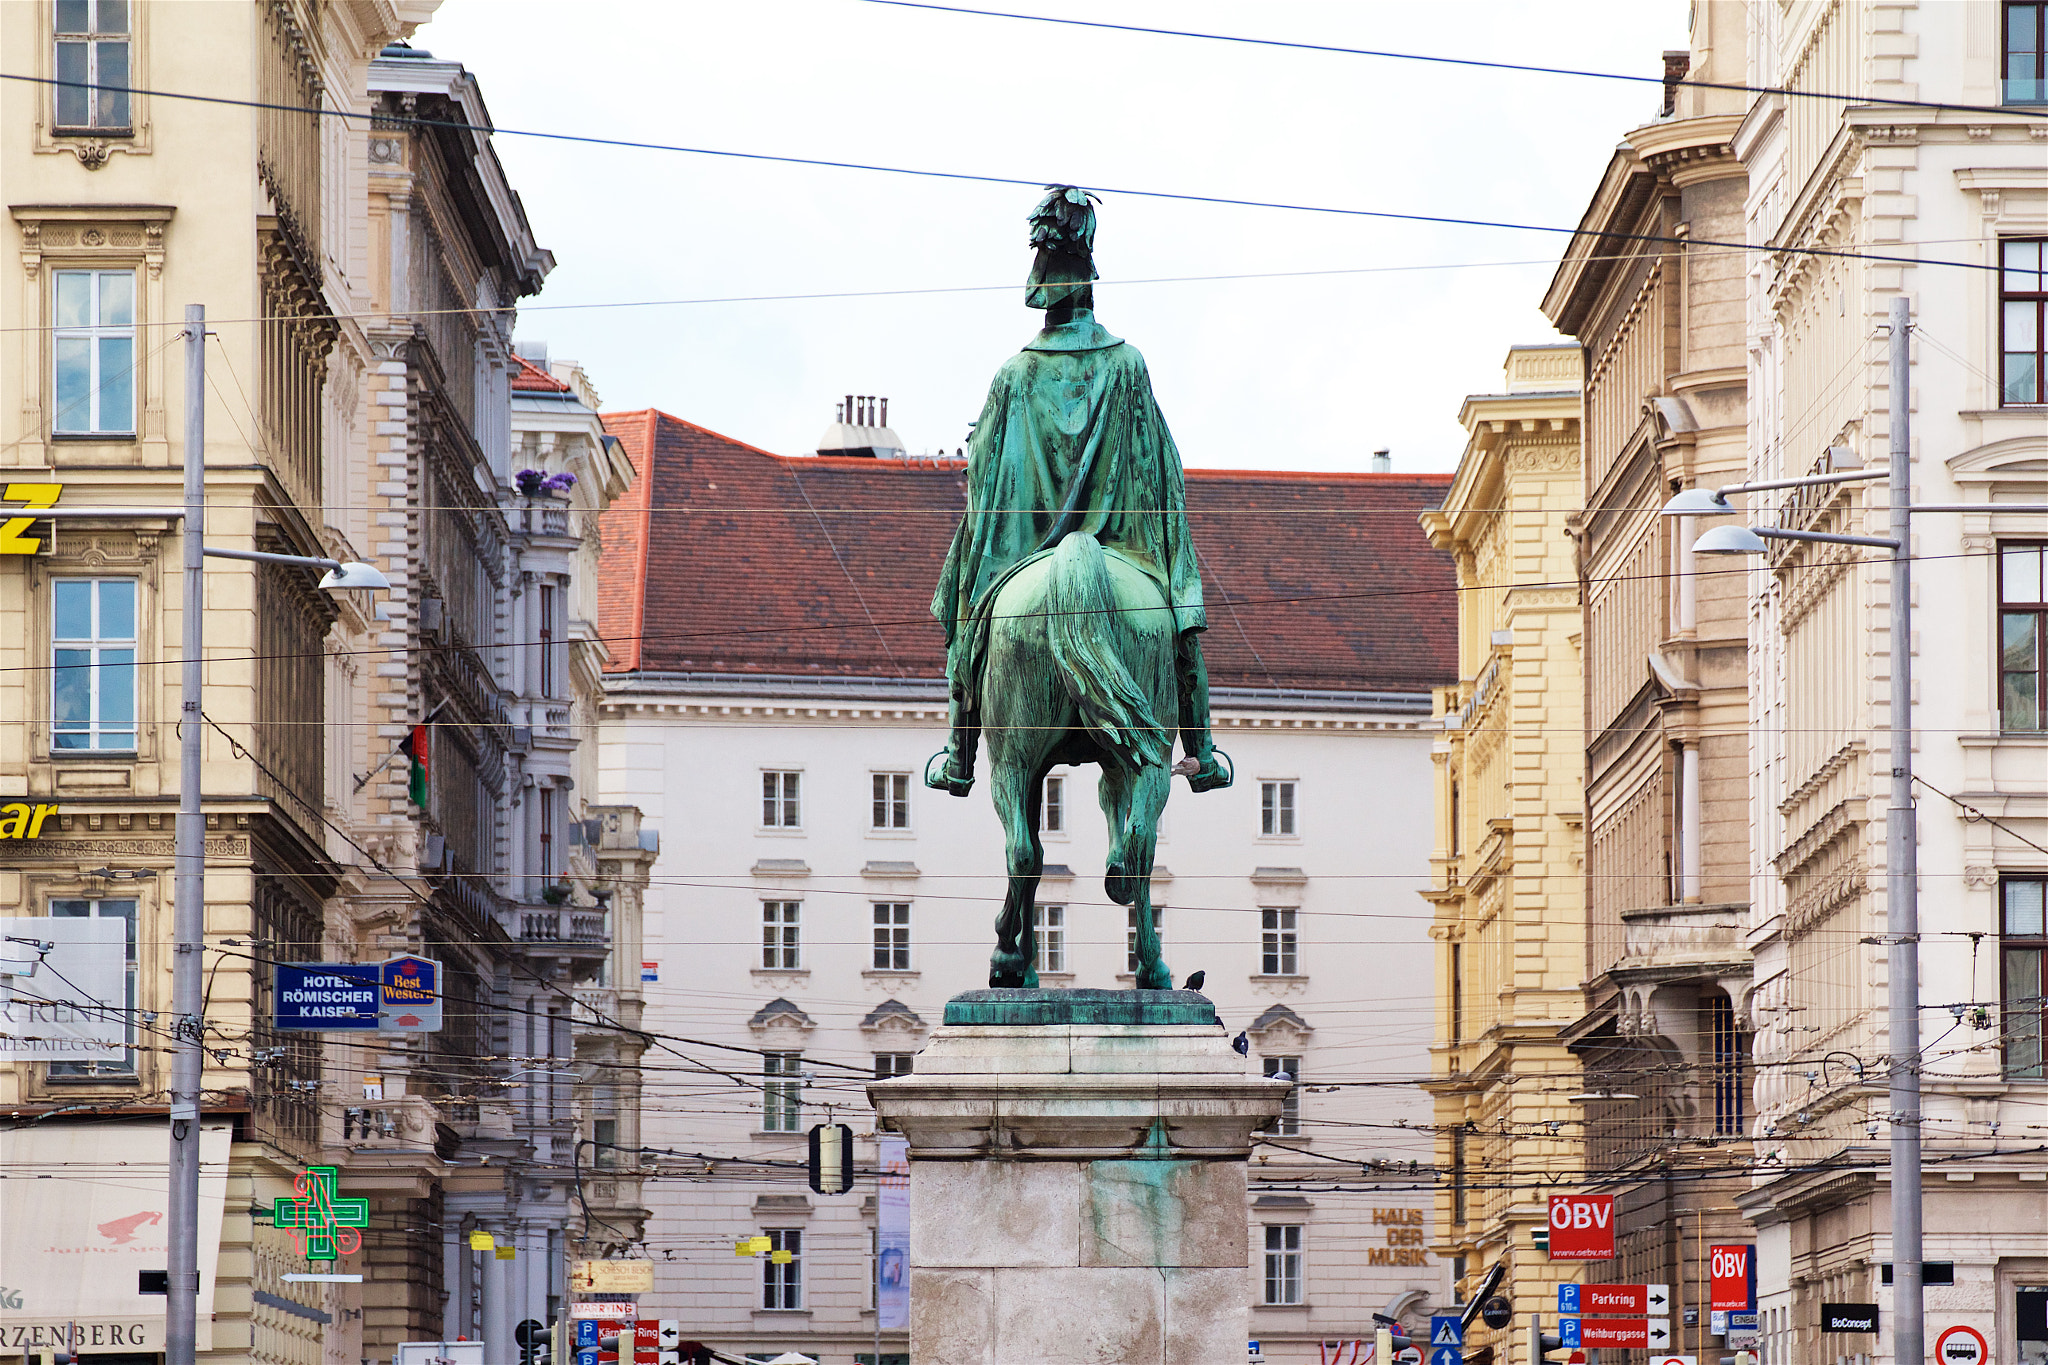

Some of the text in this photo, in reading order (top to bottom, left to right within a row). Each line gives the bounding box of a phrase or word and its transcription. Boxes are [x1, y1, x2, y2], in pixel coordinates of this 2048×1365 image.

[0, 802, 58, 839] ar
[303, 976, 353, 988] HOTEL
[393, 975, 421, 989] Best
[282, 989, 373, 1003] RÖMISCHER
[384, 986, 434, 1000] Western
[28, 999, 112, 1023] RENT
[300, 1006, 356, 1018] KAISER
[1373, 1208, 1423, 1225] HAUS
[1551, 1198, 1611, 1229] ÖBV
[1387, 1228, 1423, 1246] DER
[1368, 1248, 1428, 1266] MUSIK
[1552, 1248, 1612, 1257] www.oebv.net
[1712, 1248, 1746, 1278] ÖBV
[1591, 1293, 1635, 1308] Parkring
[574, 1304, 633, 1313] MARRYING
[1831, 1317, 1872, 1330] BoConcept
[638, 1327, 658, 1340] Ring
[1583, 1327, 1646, 1341] Weihburggasse
